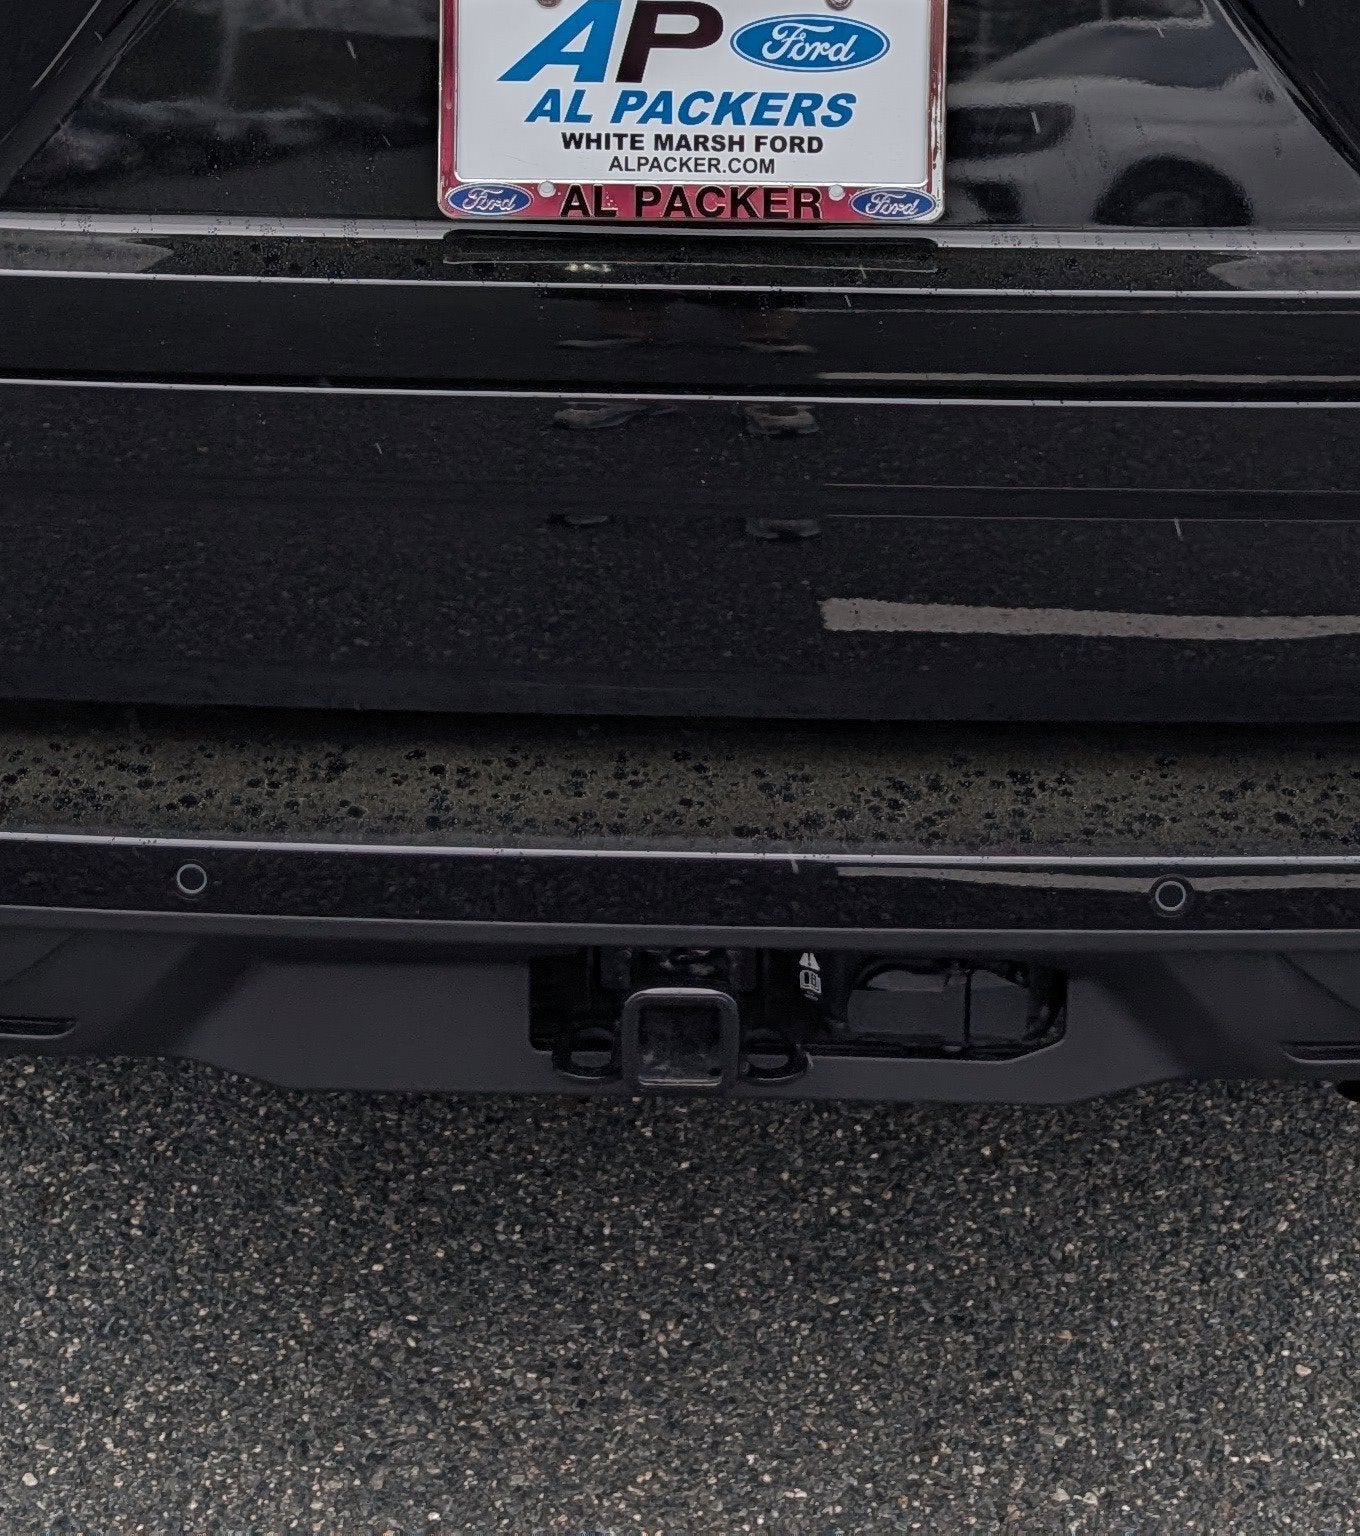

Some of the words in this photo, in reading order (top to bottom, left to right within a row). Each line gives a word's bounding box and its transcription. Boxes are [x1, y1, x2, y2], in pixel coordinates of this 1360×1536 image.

[760, 25, 860, 64] Ford
[524, 88, 594, 124] AL
[609, 90, 858, 129] PACKERS
[560, 131, 646, 152] WHITE
[653, 133, 746, 154] MARSH
[753, 135, 824, 155] FORD
[608, 155, 776, 175] ALPACKER.COM
[461, 187, 518, 211] Ford
[558, 185, 619, 218] AL
[634, 186, 824, 221] PACKER
[864, 192, 923, 217] Ford
